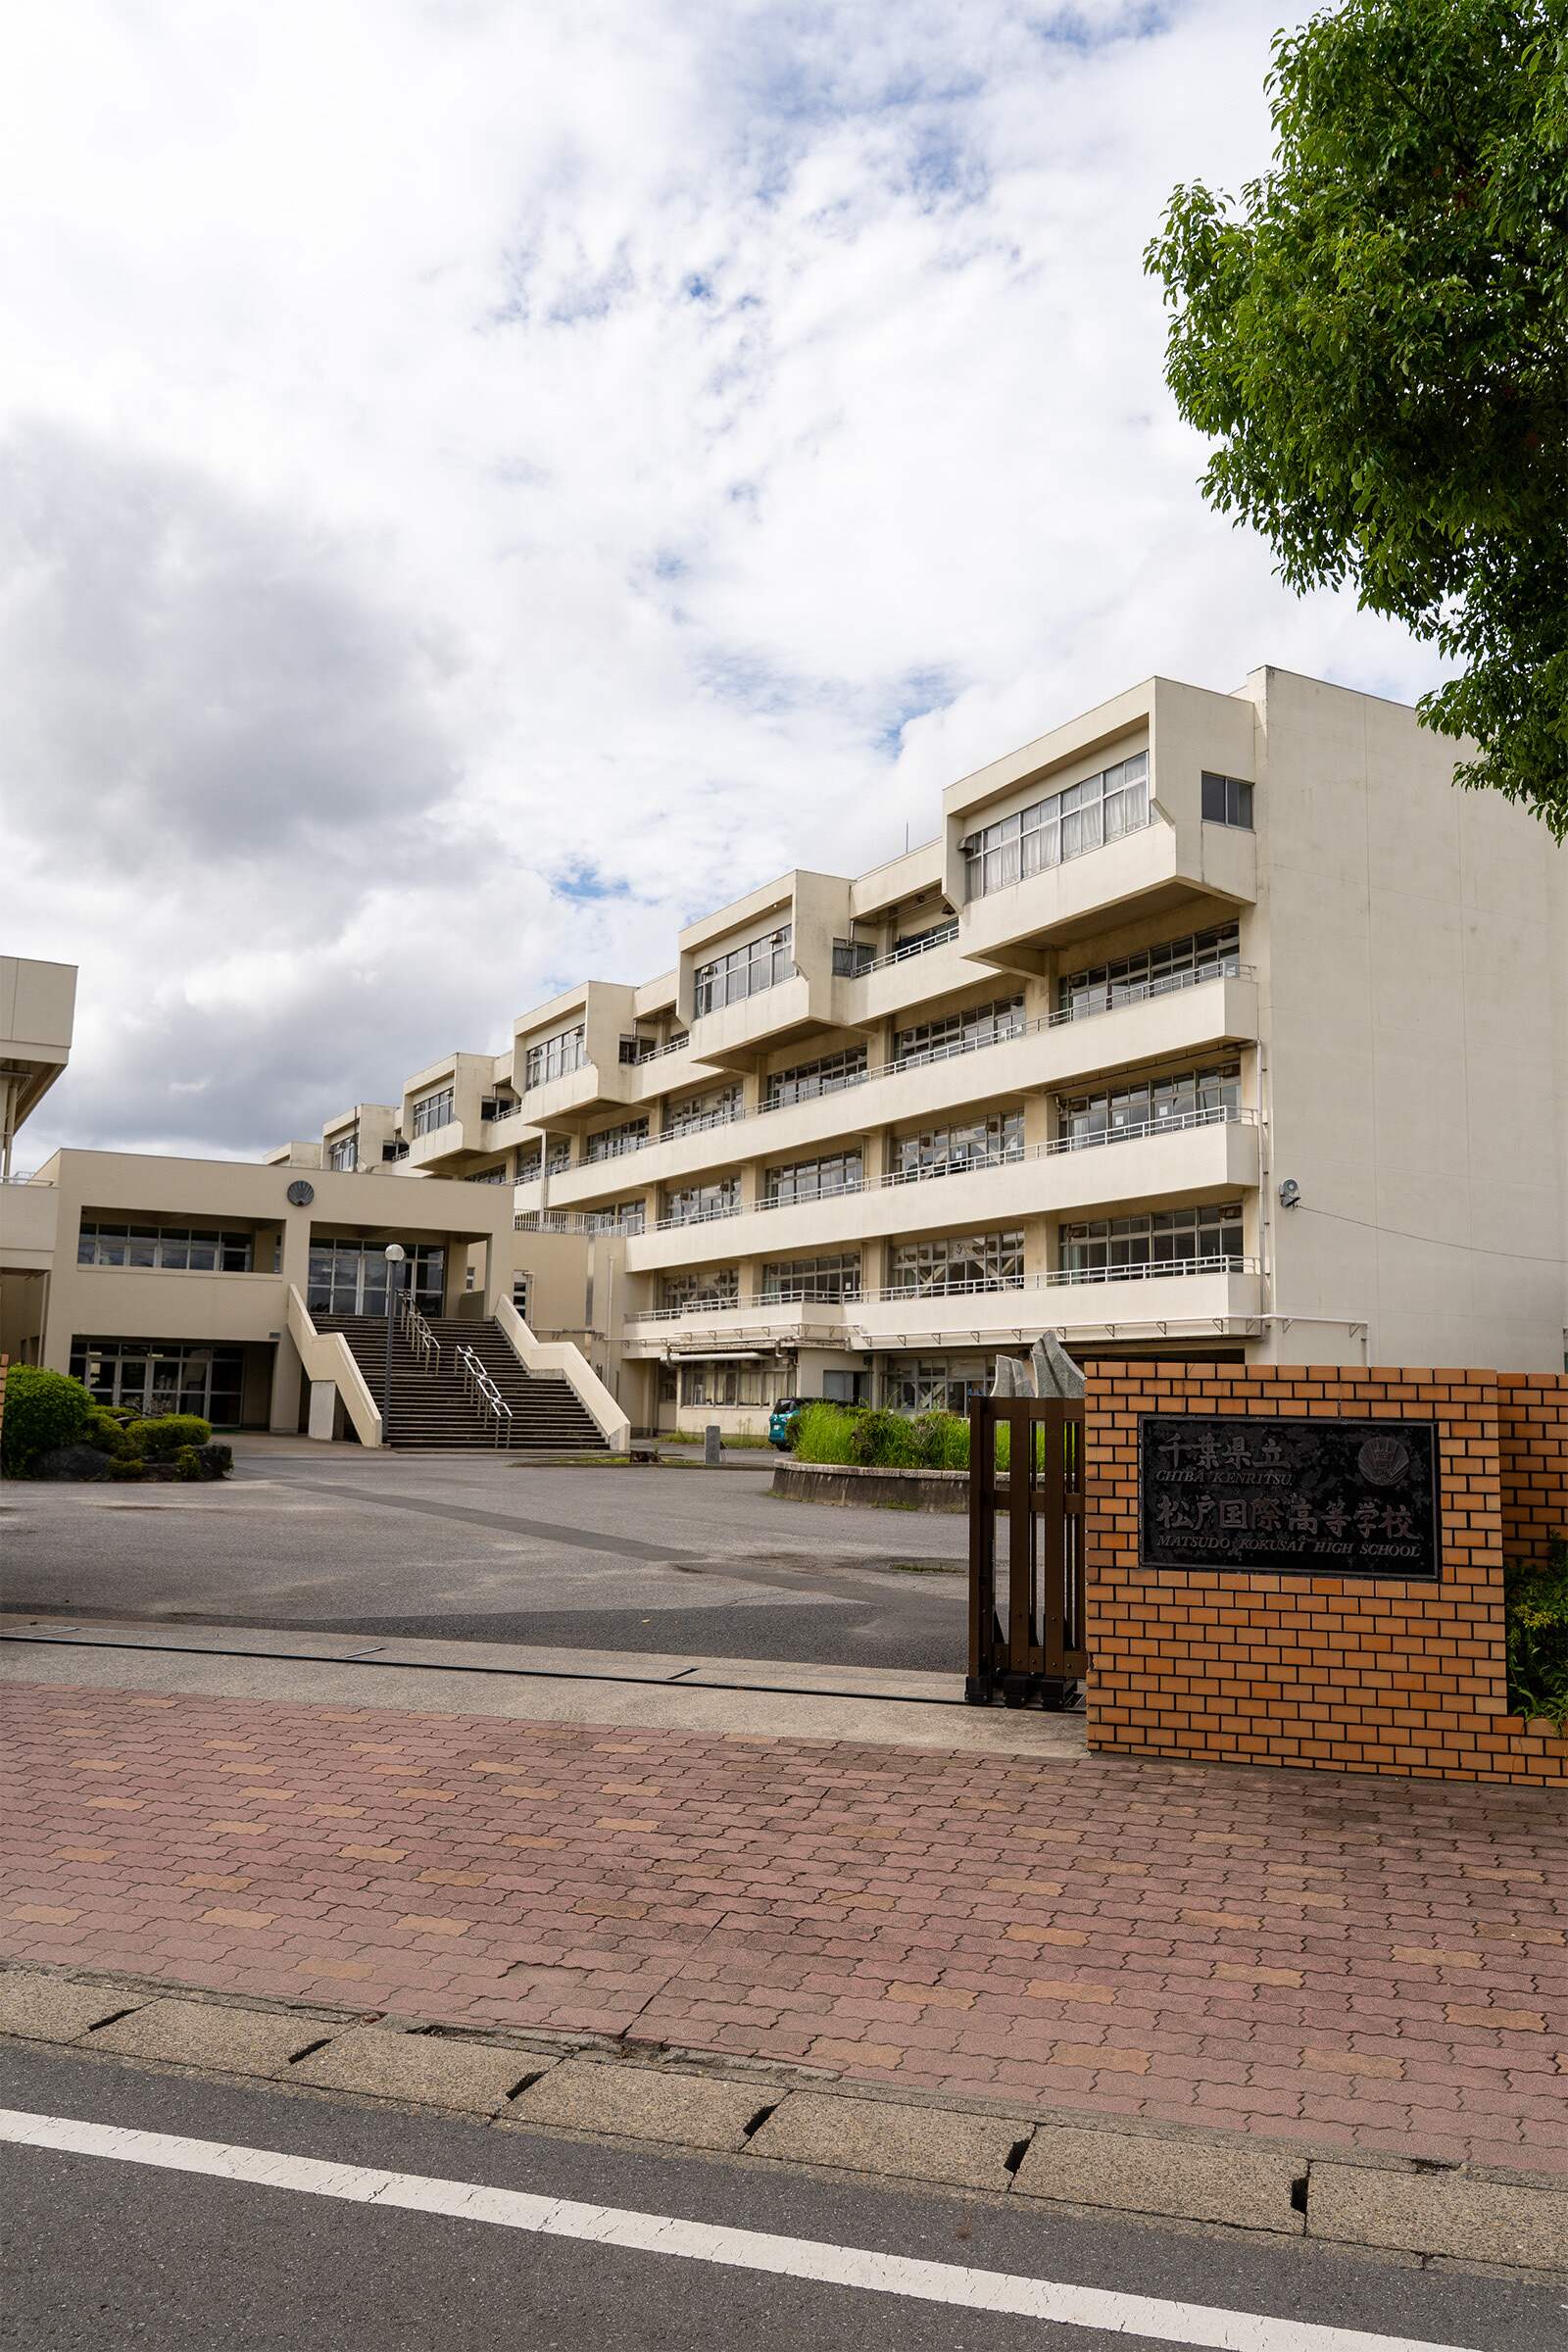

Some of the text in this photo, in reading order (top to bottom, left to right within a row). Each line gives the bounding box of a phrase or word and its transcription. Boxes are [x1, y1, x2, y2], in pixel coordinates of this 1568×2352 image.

[1157, 1432, 1292, 1469] 千葉県立
[1156, 1470, 1205, 1483] CHIBA
[1156, 1494, 1420, 1540] 松戸国際高等学校
[1157, 1535, 1420, 1556] MATSUDO KOKUSAI HIGH SCHOOL
